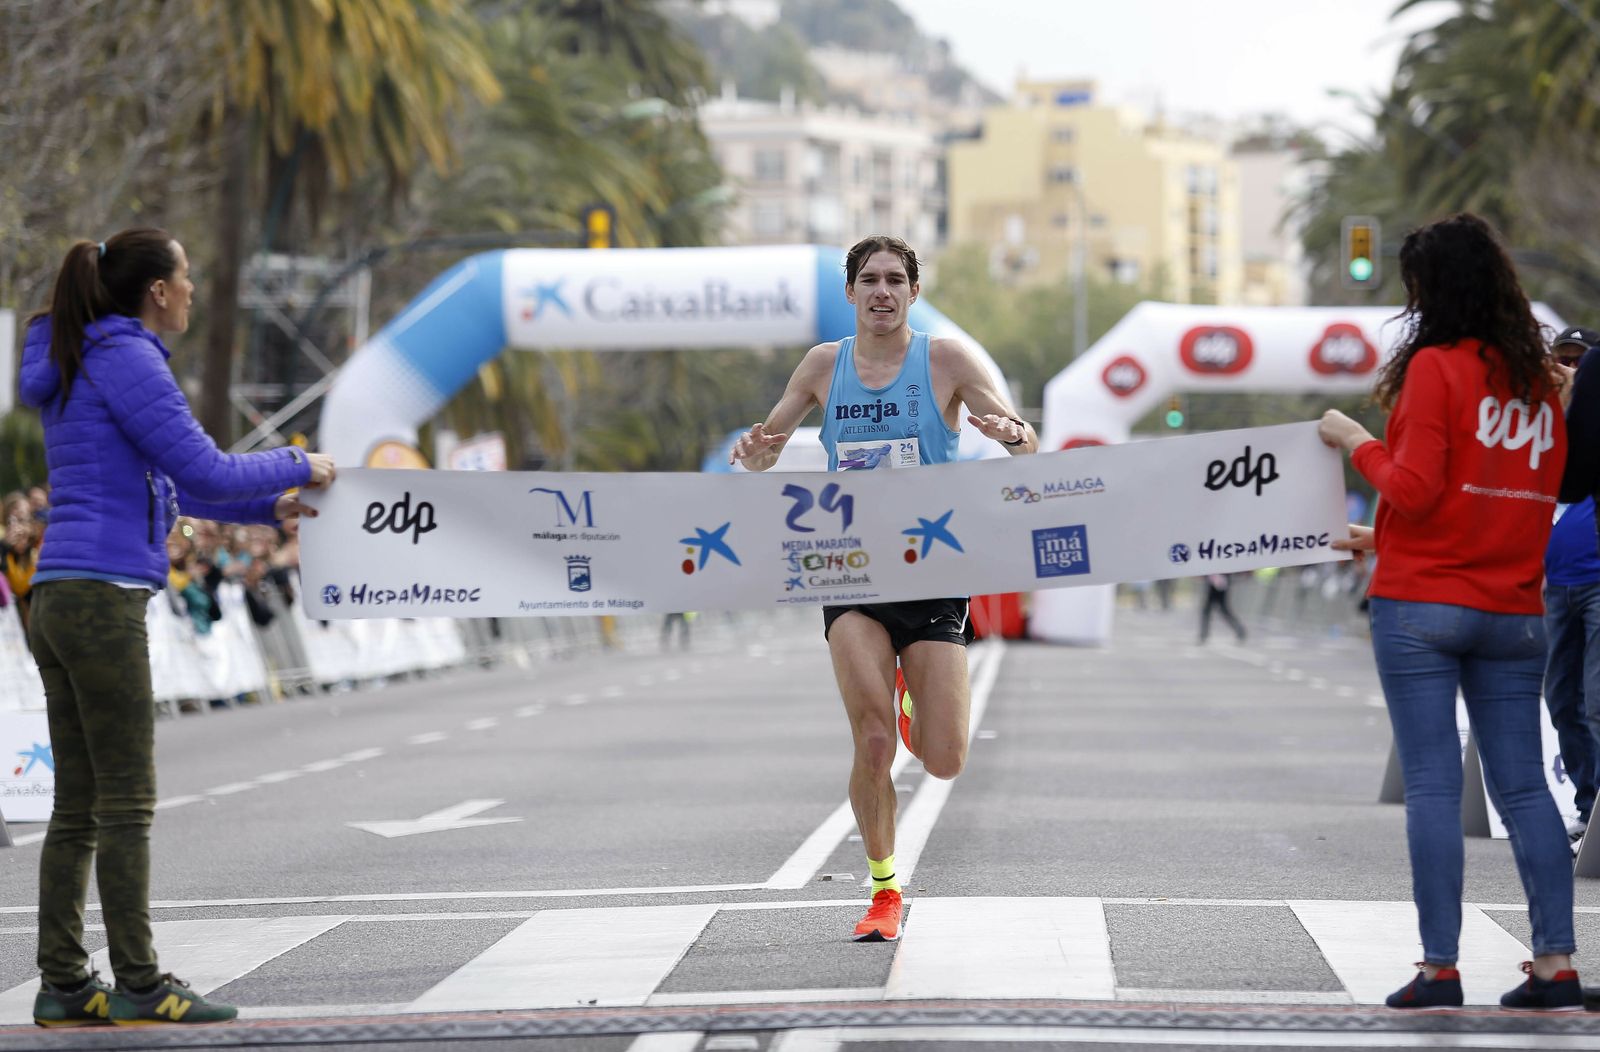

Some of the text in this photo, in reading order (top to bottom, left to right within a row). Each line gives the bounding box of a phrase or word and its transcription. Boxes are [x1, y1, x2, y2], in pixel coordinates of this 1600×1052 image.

[583, 277, 800, 322] CaixaBank
[835, 399, 900, 423] nerja
[843, 424, 890, 435] ATLETISMO
[1204, 445, 1279, 496] edp
[362, 491, 437, 544] edp
[528, 487, 597, 528] M
[781, 482, 854, 533] 29
[782, 537, 861, 552] MEDIA MARATÓN
[808, 573, 872, 588] CaixaBank
[519, 598, 644, 611] Ayuntamiento de Málaga
